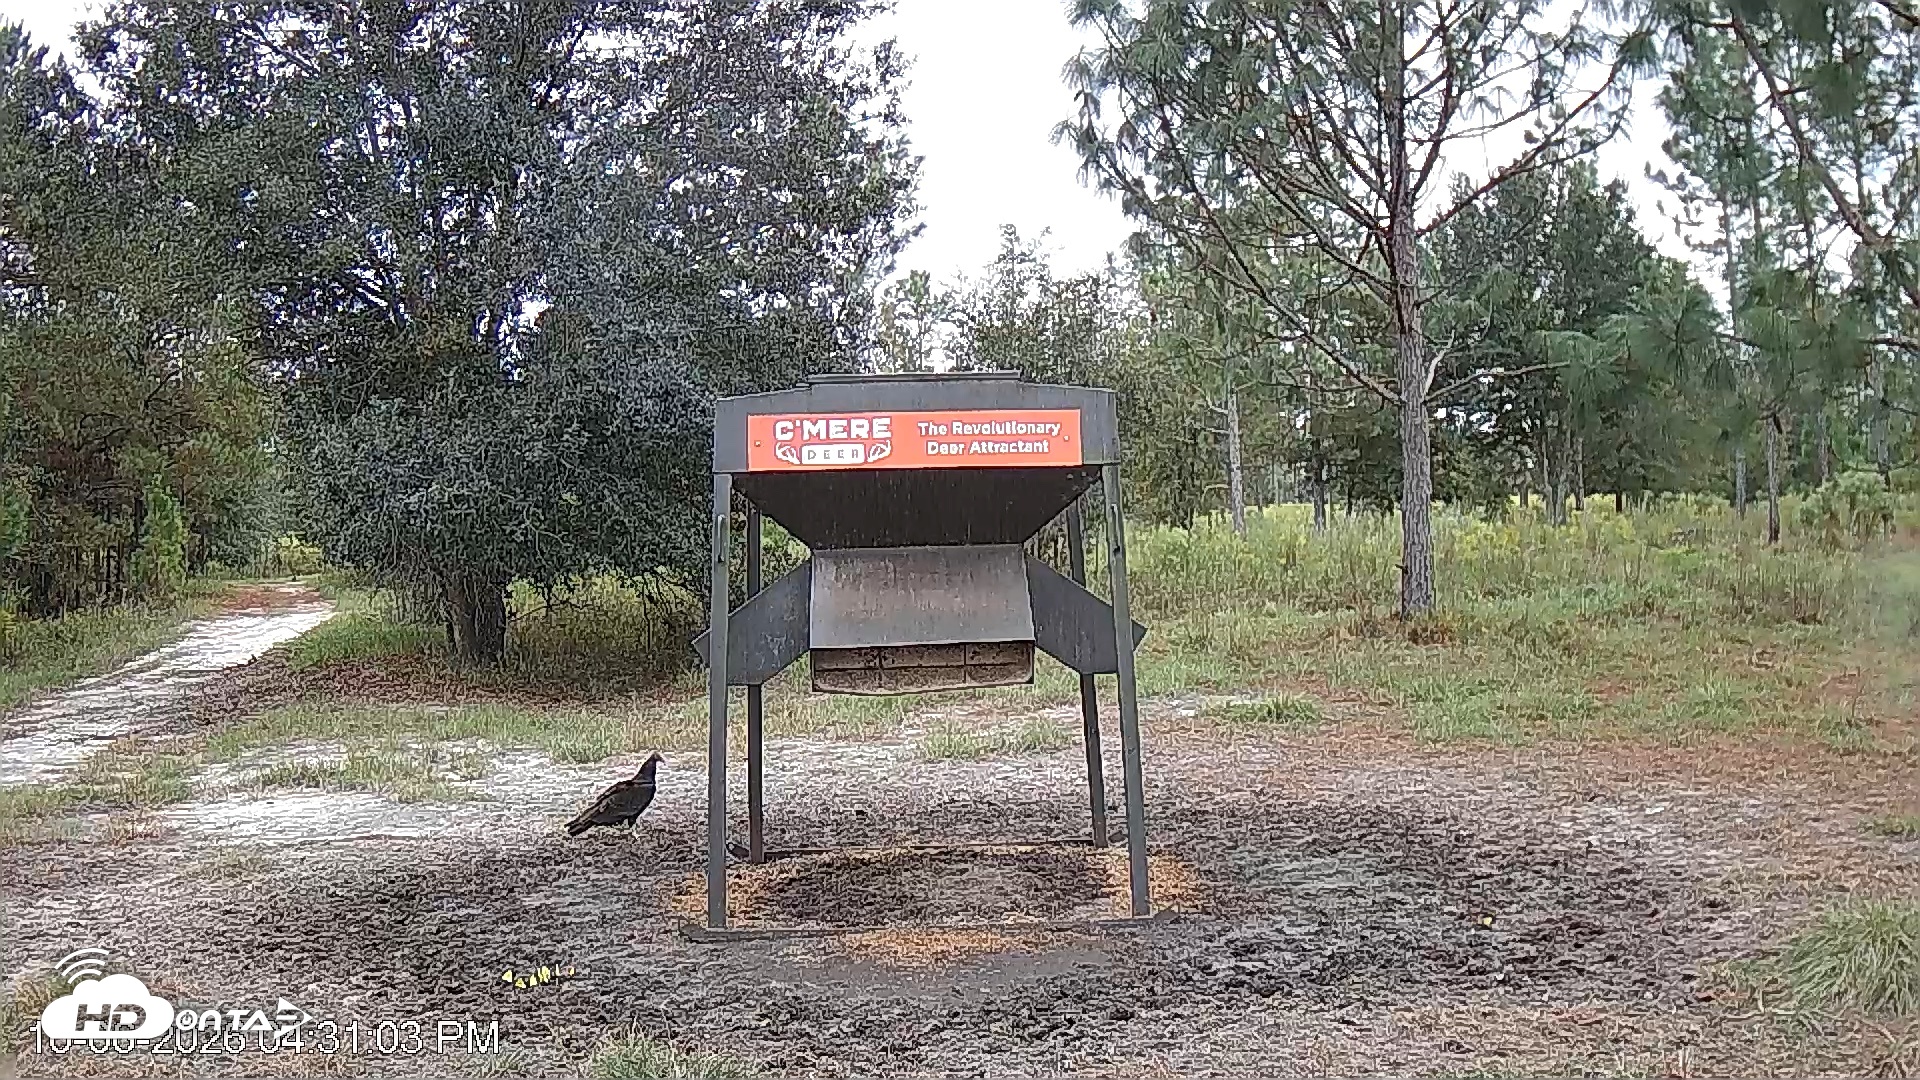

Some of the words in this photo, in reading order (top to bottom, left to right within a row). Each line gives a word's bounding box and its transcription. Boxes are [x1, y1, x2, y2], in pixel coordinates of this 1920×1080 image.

[774, 417, 892, 441] C'MERE
[917, 421, 948, 436] The
[951, 420, 1061, 437] Revolutionary
[806, 448, 860, 461] DEER
[926, 441, 965, 455] Deer
[968, 440, 1050, 455] Attractant
